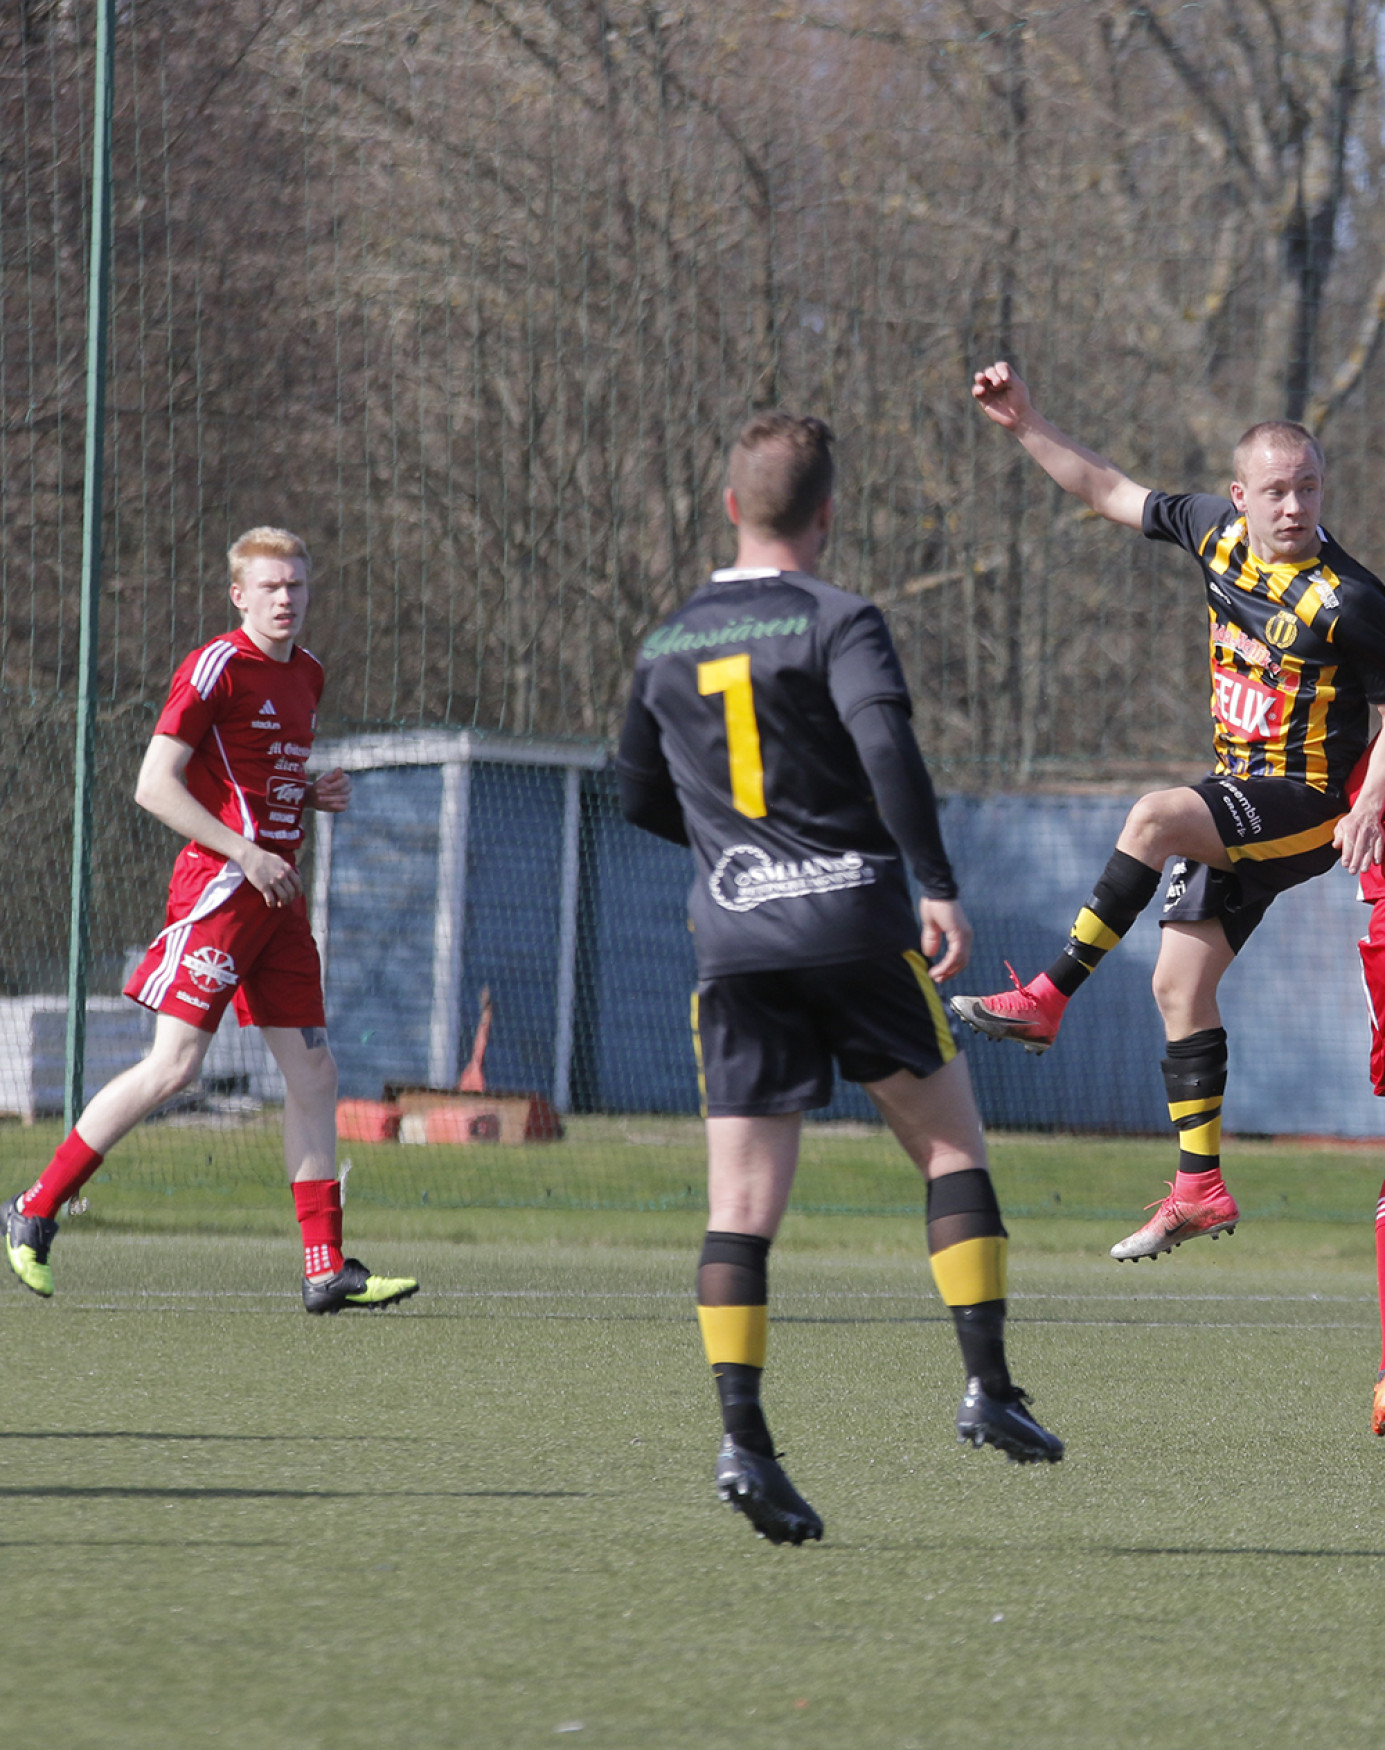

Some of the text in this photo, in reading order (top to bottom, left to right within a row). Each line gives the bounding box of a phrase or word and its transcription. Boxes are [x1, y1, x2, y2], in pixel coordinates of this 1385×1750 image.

[698, 654, 767, 819] 1
[1213, 671, 1277, 737] FELIX
[176, 989, 210, 1011] stadium
